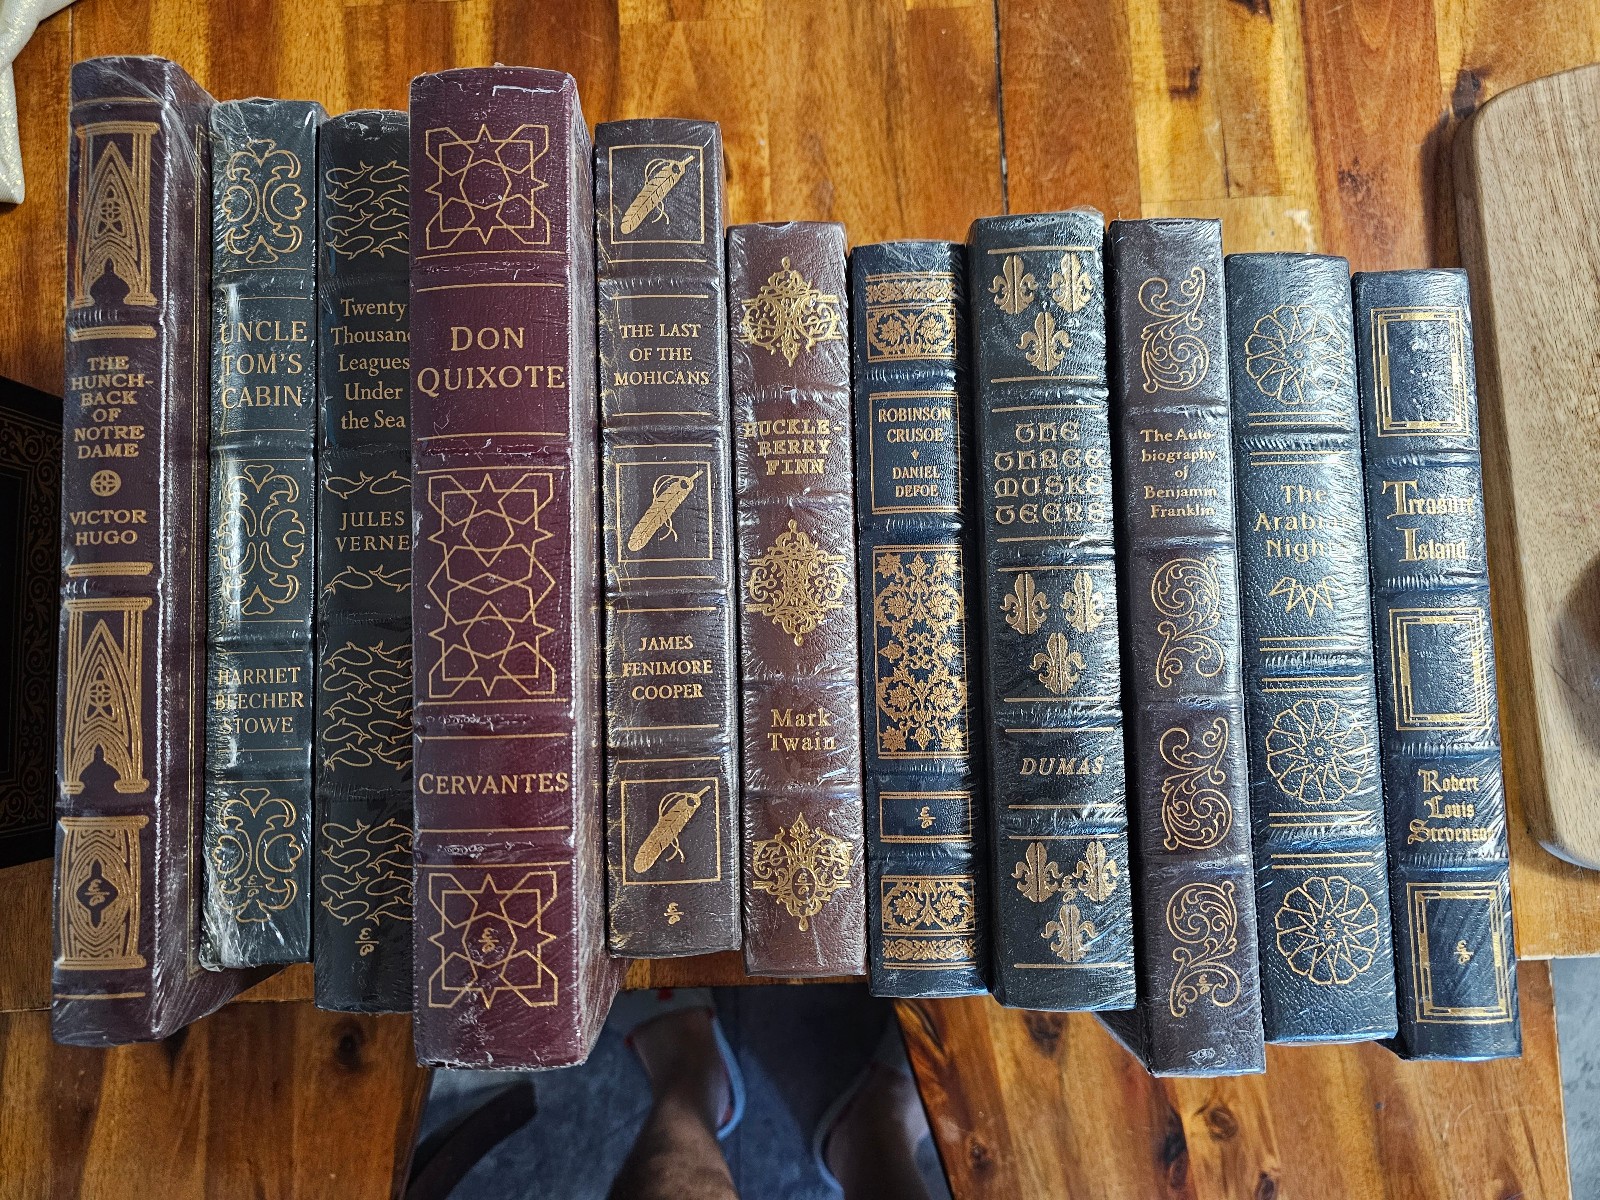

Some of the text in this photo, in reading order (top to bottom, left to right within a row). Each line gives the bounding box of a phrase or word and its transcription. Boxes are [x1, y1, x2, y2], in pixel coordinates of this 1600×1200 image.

[340, 298, 408, 322] Twenty
[219, 321, 307, 344] UNCLE
[451, 326, 525, 351] DON
[619, 323, 701, 339] THE LAST
[629, 347, 693, 362] OF THE
[87, 356, 129, 372] THE
[221, 353, 302, 376] TOM'S
[338, 354, 410, 376] Leagues
[71, 374, 154, 390] HUNCH-
[417, 365, 565, 398] QUIXOTE
[614, 371, 711, 387] MOHICANS
[81, 390, 138, 406] BACK
[221, 385, 302, 409] CABIN
[345, 382, 403, 401] Under
[92, 408, 122, 423] OF
[341, 410, 406, 430] the Sea
[878, 407, 951, 423] ROBINSON
[74, 425, 145, 442] NOTRE
[886, 428, 944, 443] CRUSOE
[1140, 429, 1173, 442] The
[78, 443, 139, 459] DAME
[757, 439, 831, 457] BERRY
[1142, 447, 1216, 464] biography
[765, 458, 825, 475] FINN
[892, 465, 941, 480] DANIEL
[1175, 464, 1189, 480] of
[896, 484, 939, 498] DEFOE
[1144, 485, 1218, 499] Benjamin
[1280, 484, 1327, 504] The
[69, 509, 148, 526] VICTOR
[1151, 504, 1215, 518] Franklin
[340, 511, 405, 531] JULES
[75, 530, 137, 546] HUGO
[335, 535, 411, 552] VERNE
[1395, 526, 1467, 562] Island
[639, 636, 694, 651] JAMES
[217, 667, 301, 685] HARRIET
[622, 660, 713, 677] FENIMORE
[632, 683, 704, 700] COOPER
[215, 691, 304, 710] BEECHER
[223, 717, 294, 734] STOWE
[771, 708, 831, 728] Mark
[767, 732, 837, 751] Twain
[1020, 755, 1104, 775] DUMAS
[419, 772, 570, 795] CERVANTES
[1417, 768, 1480, 793] Robert
[1424, 795, 1475, 818] Louis
